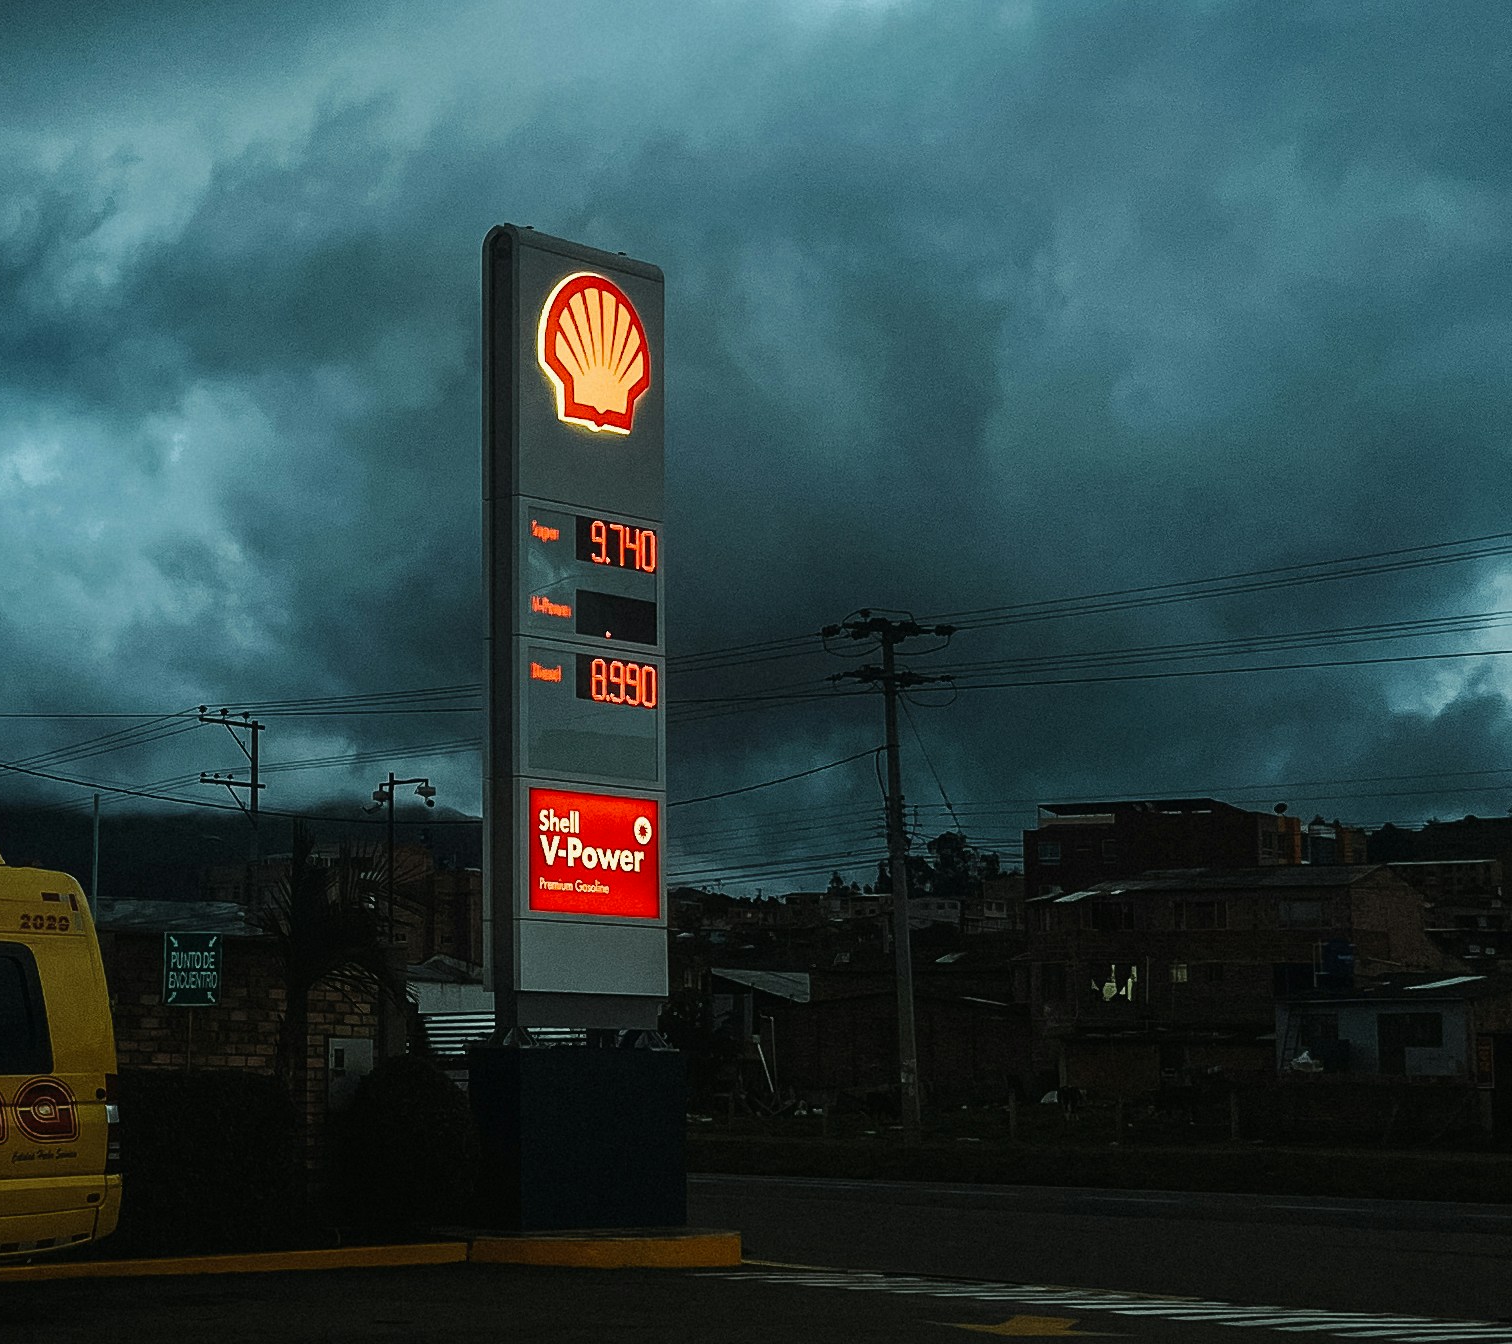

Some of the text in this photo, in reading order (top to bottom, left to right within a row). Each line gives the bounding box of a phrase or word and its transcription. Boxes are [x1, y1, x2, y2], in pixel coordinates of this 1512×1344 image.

[591, 520, 657, 573] 9.740
[591, 658, 657, 709] 8.990
[538, 808, 580, 834] Shell
[539, 834, 645, 873] V-Power
[539, 876, 610, 895] Premium Gasoline
[170, 951, 216, 969] PUNTO DE
[168, 971, 218, 989] ENCUENTRO
